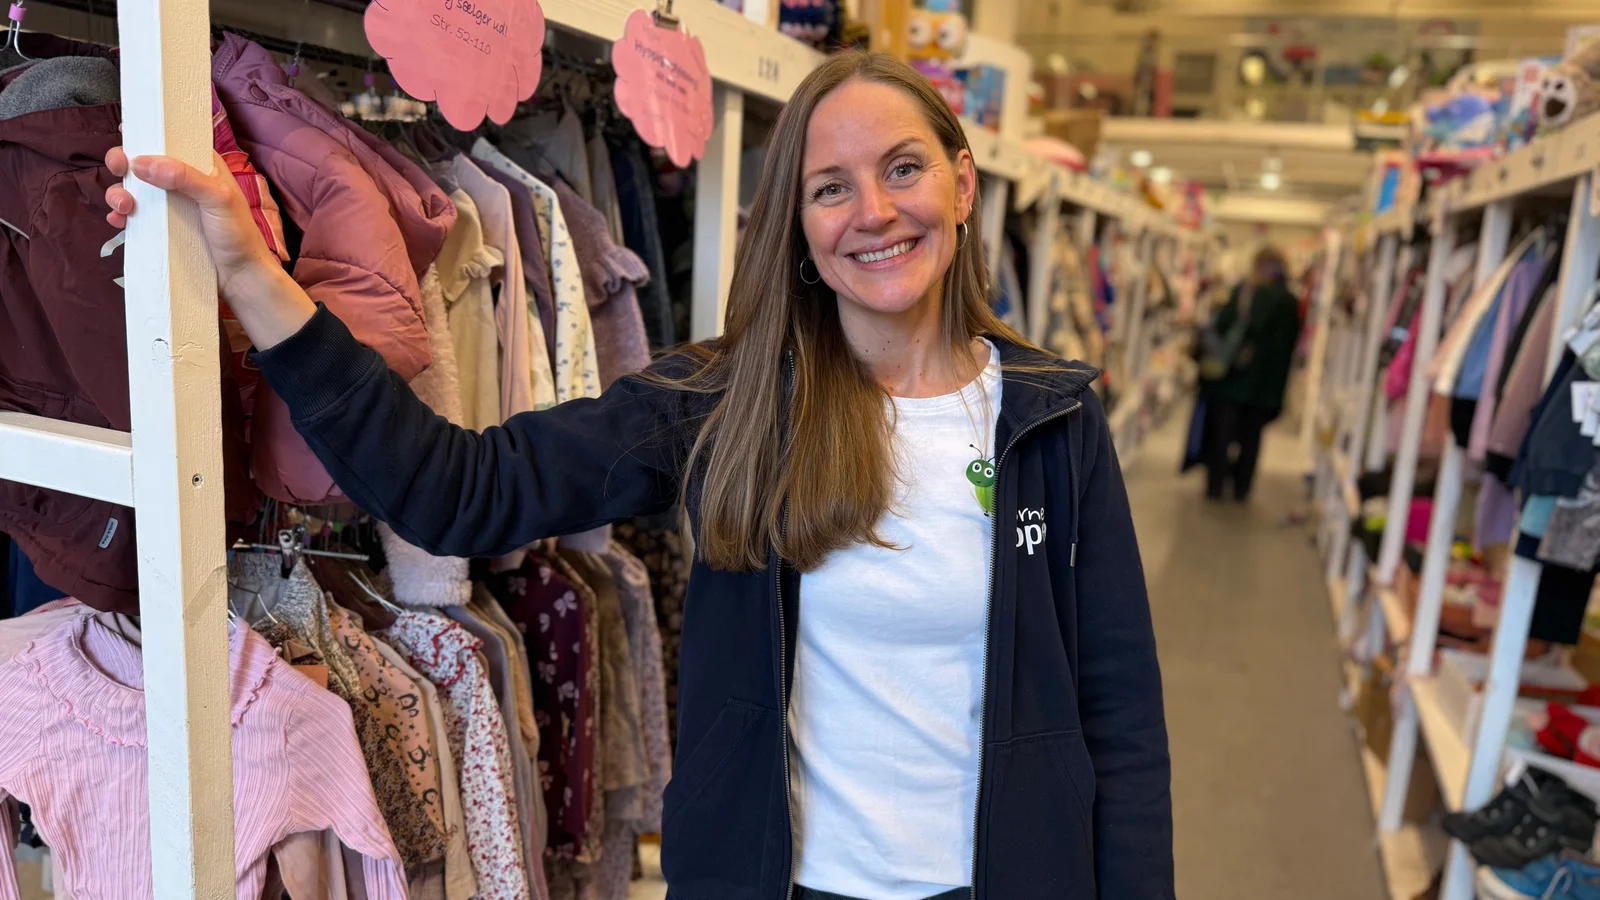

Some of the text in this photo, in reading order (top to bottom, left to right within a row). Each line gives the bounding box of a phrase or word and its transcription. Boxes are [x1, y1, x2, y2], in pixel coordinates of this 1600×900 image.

[430, 14, 491, 55] Str. 52-110
[493, 21, 508, 37] ud!
[1016, 507, 1045, 522] rne
